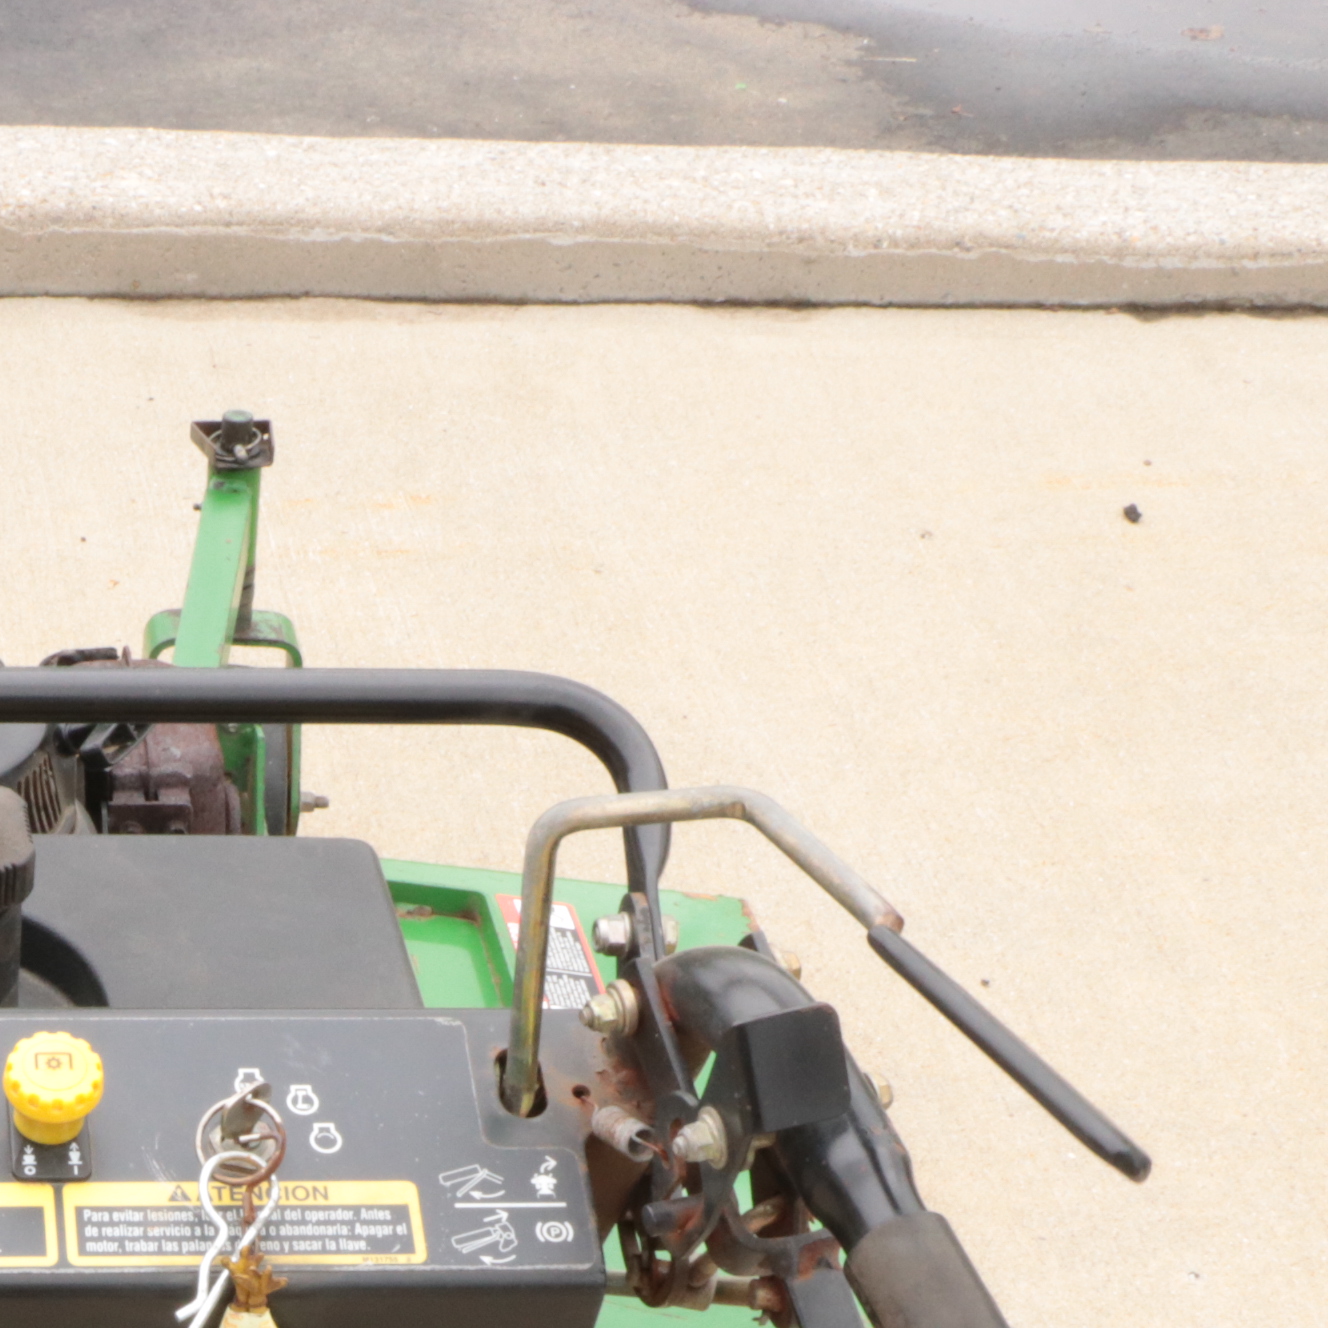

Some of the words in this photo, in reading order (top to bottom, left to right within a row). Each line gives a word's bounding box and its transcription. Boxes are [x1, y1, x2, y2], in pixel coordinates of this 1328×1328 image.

[197, 1184, 329, 1203] TENCION
[83, 1209, 110, 1222] Para
[112, 1209, 144, 1222] evitar
[147, 1208, 199, 1223] lesiones,
[284, 1207, 302, 1221] del
[305, 1207, 358, 1224] operador.
[360, 1207, 392, 1221] Antes
[84, 1225, 99, 1237] de
[101, 1225, 144, 1237] realizar
[147, 1224, 192, 1237] servicio
[194, 1227, 202, 1237] a
[204, 1224, 215, 1236] la
[269, 1226, 277, 1236] o
[279, 1223, 352, 1236] abandonarla:
[354, 1223, 394, 1239] Apagar
[396, 1222, 408, 1236] el
[86, 1240, 123, 1253] motor,
[125, 1240, 159, 1252] trabar
[162, 1240, 179, 1252] las
[181, 1240, 233, 1256] palanas
[282, 1241, 290, 1254] y
[292, 1240, 322, 1252] sacar
[325, 1239, 336, 1251] la
[339, 1238, 372, 1251] llave.
